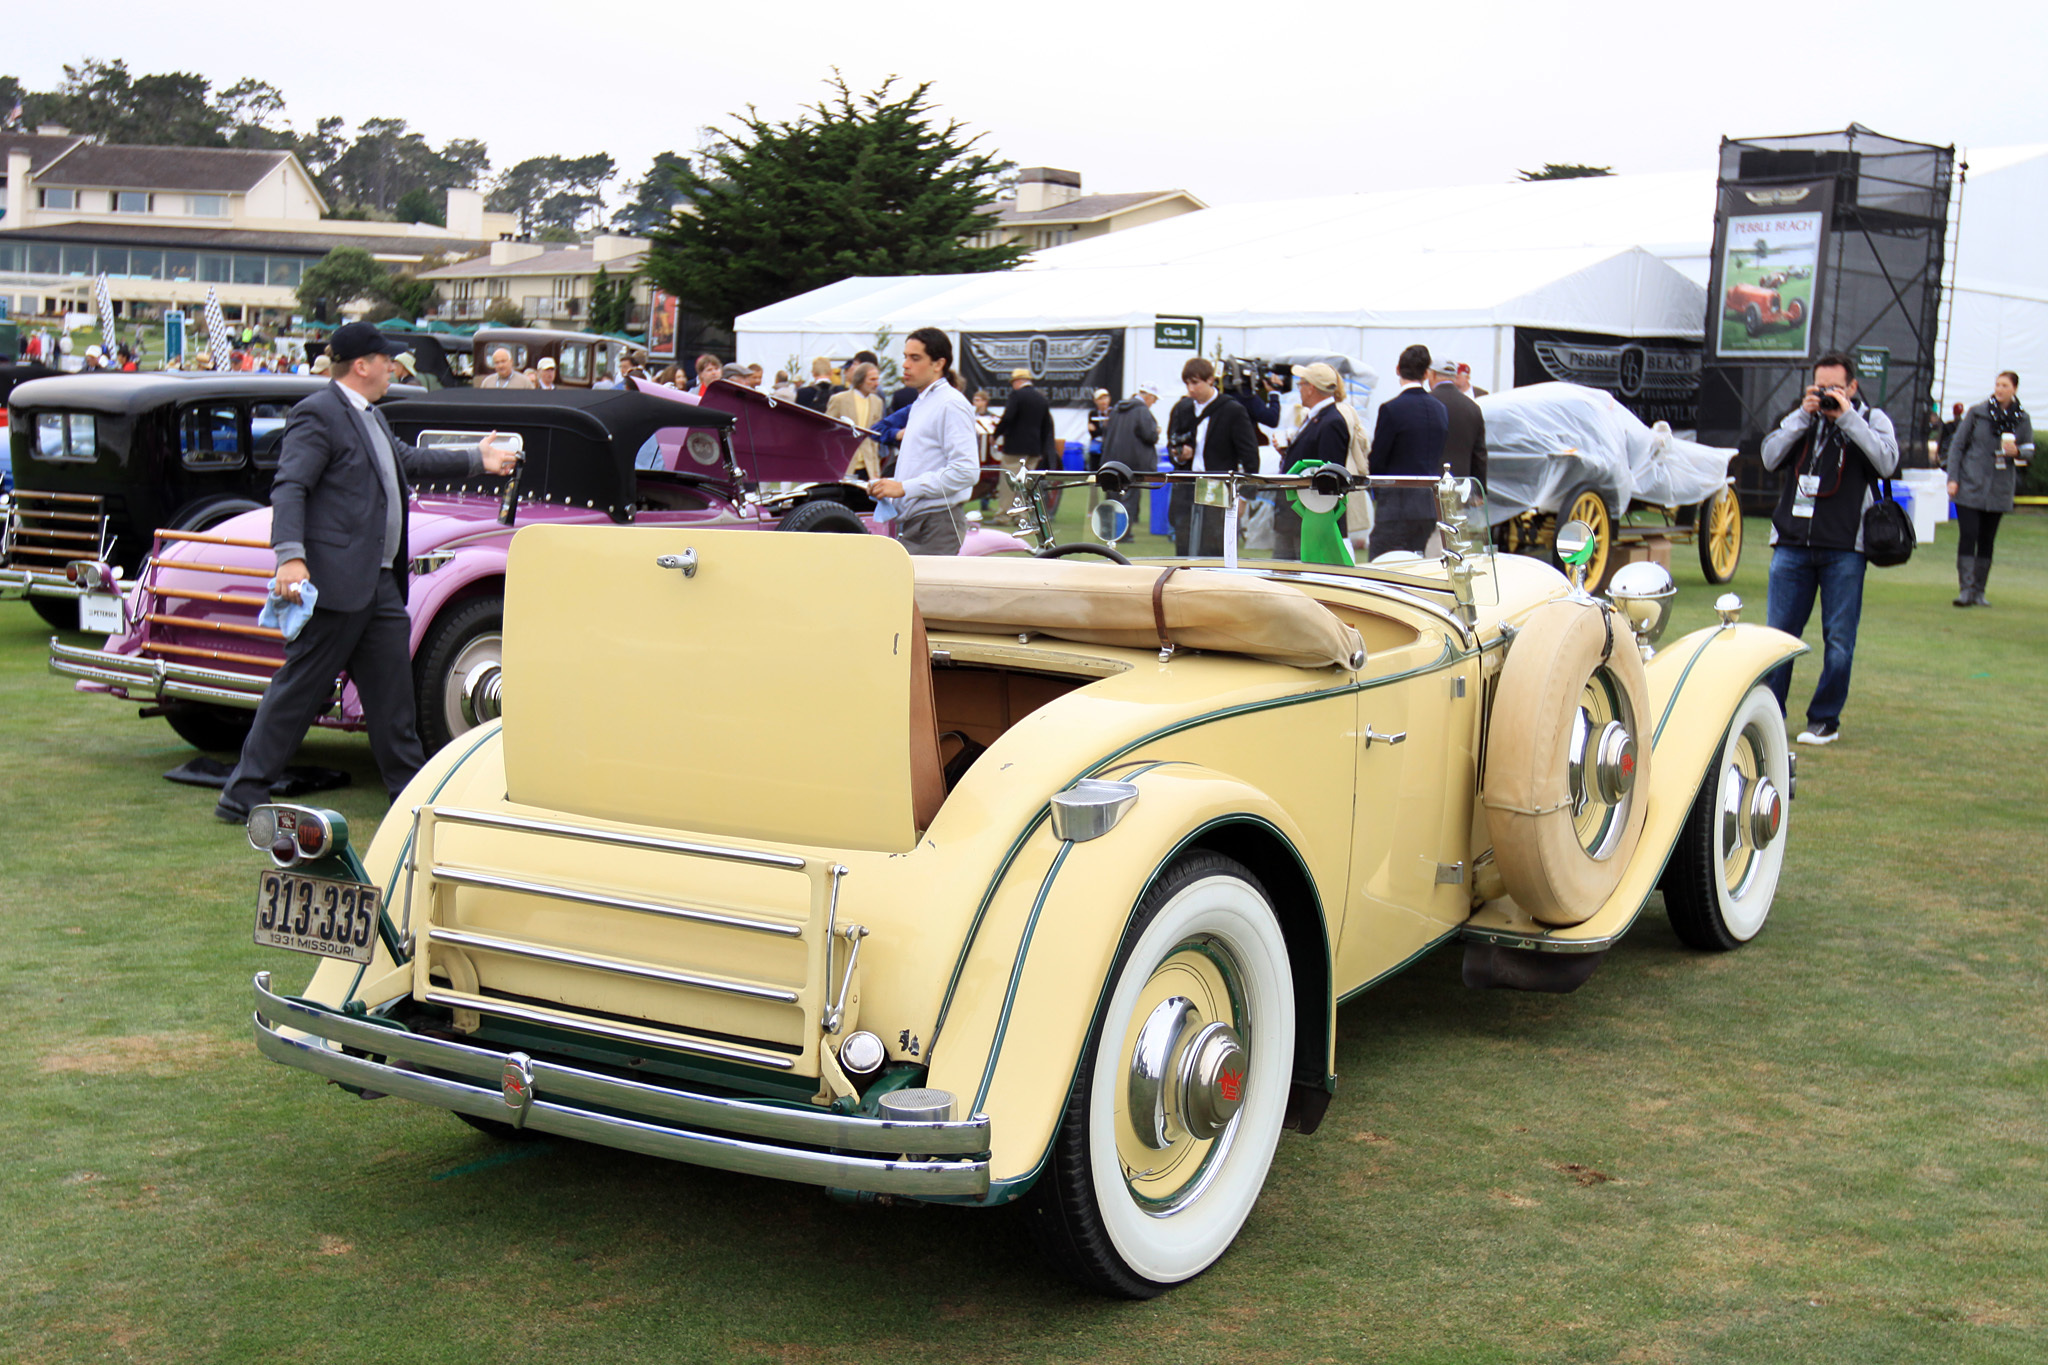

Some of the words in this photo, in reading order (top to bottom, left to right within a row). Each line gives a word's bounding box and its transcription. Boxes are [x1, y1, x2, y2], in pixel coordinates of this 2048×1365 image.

[1735, 222, 1772, 234] PEBBLE
[1775, 220, 1813, 232] BEACH
[994, 344, 1028, 356] PEBBLE
[1049, 342, 1083, 355] BEACH
[1569, 352, 1618, 367] PEBBLE
[1647, 355, 1692, 370] BEACH
[93, 610, 118, 618] PETERSEN
[298, 825, 321, 846] STOP
[270, 933, 295, 947] 1931
[297, 938, 355, 956] MISSOURI
